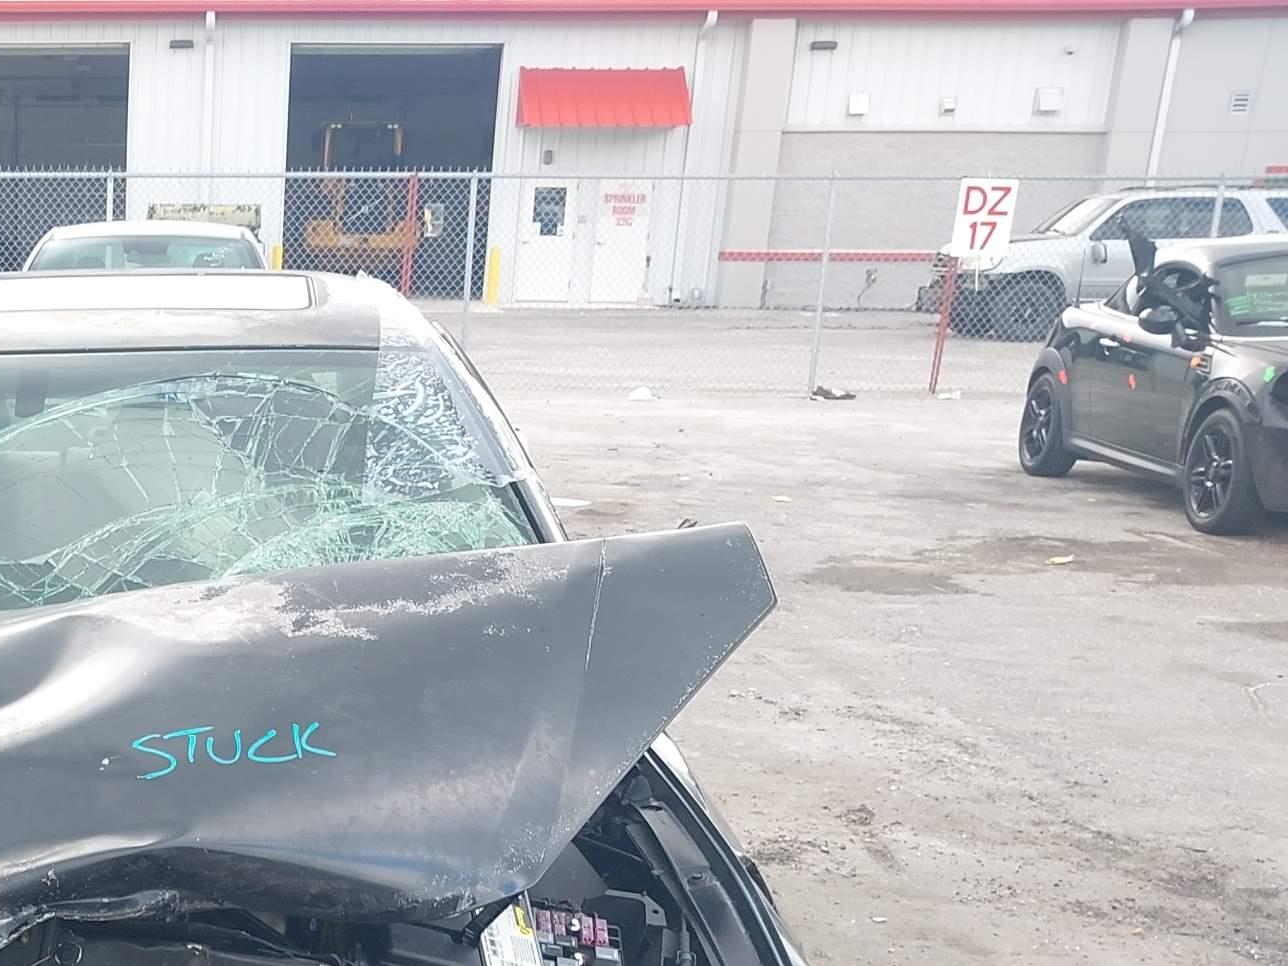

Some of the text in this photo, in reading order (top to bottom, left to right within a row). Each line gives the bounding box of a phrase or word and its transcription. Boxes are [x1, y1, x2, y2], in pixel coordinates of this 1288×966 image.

[612, 205, 636, 216] ROOM
[962, 185, 1012, 216] DZ
[969, 221, 998, 250] 17
[131, 721, 337, 780] STUCK
